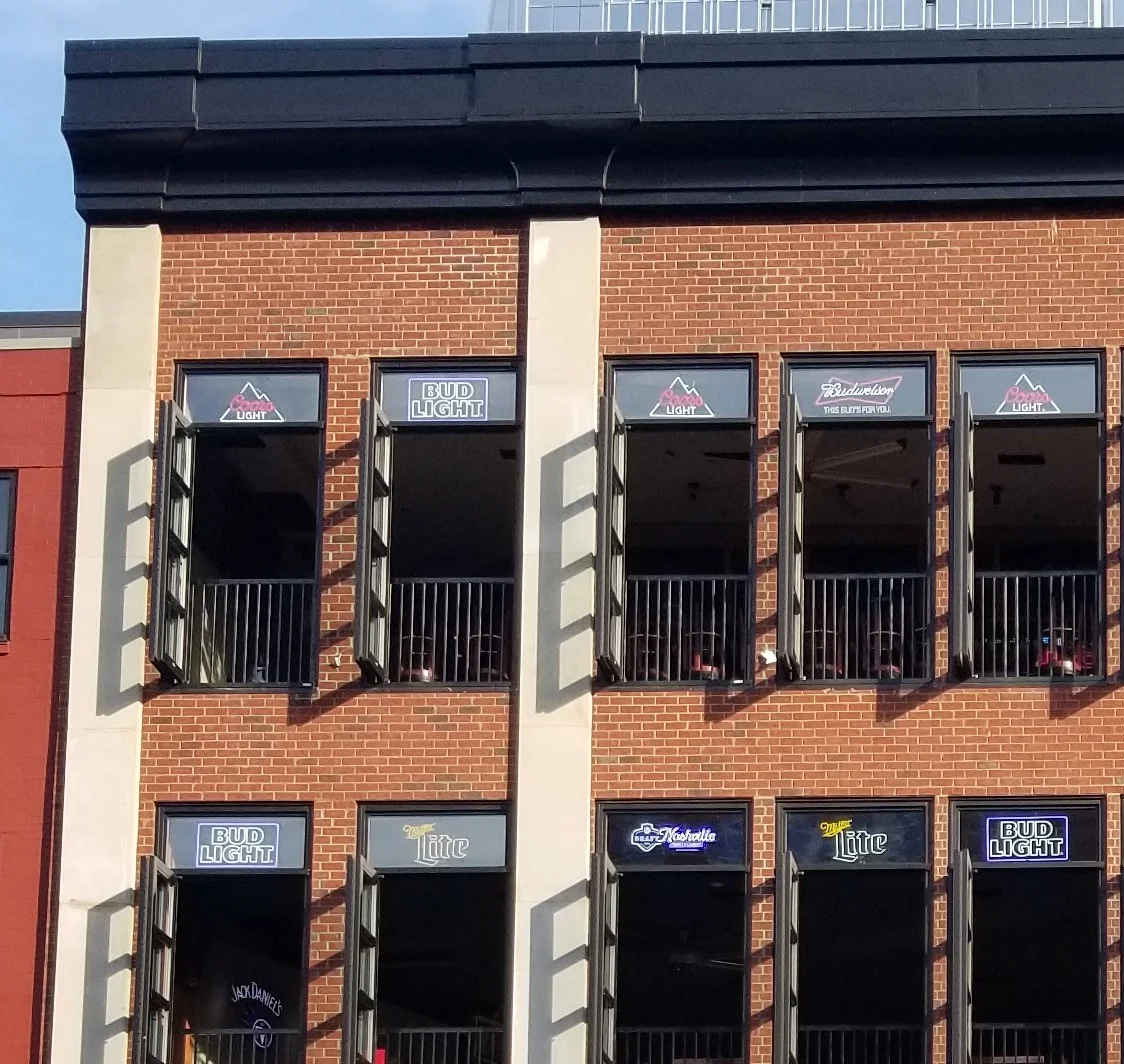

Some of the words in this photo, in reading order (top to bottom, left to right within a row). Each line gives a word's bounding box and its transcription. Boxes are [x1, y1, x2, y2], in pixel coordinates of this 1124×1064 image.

[422, 382, 474, 400] BUD
[821, 383, 895, 397] Budweiser
[236, 411, 266, 421] LIGHT
[412, 400, 483, 418] LIGHT
[666, 405, 696, 415] LIGHT
[862, 405, 876, 413] FOR
[1012, 402, 1046, 412] LIGHT
[211, 827, 264, 845] BUD
[660, 827, 717, 843] Nashville
[1000, 823, 1053, 839] BUD
[200, 845, 275, 864] LIGHT
[412, 833, 470, 867] Lite
[832, 831, 888, 862] Lite
[988, 838, 1065, 857] LIGHT
[231, 984, 251, 1003] JACK
[251, 981, 283, 1017] DANIEL'S
